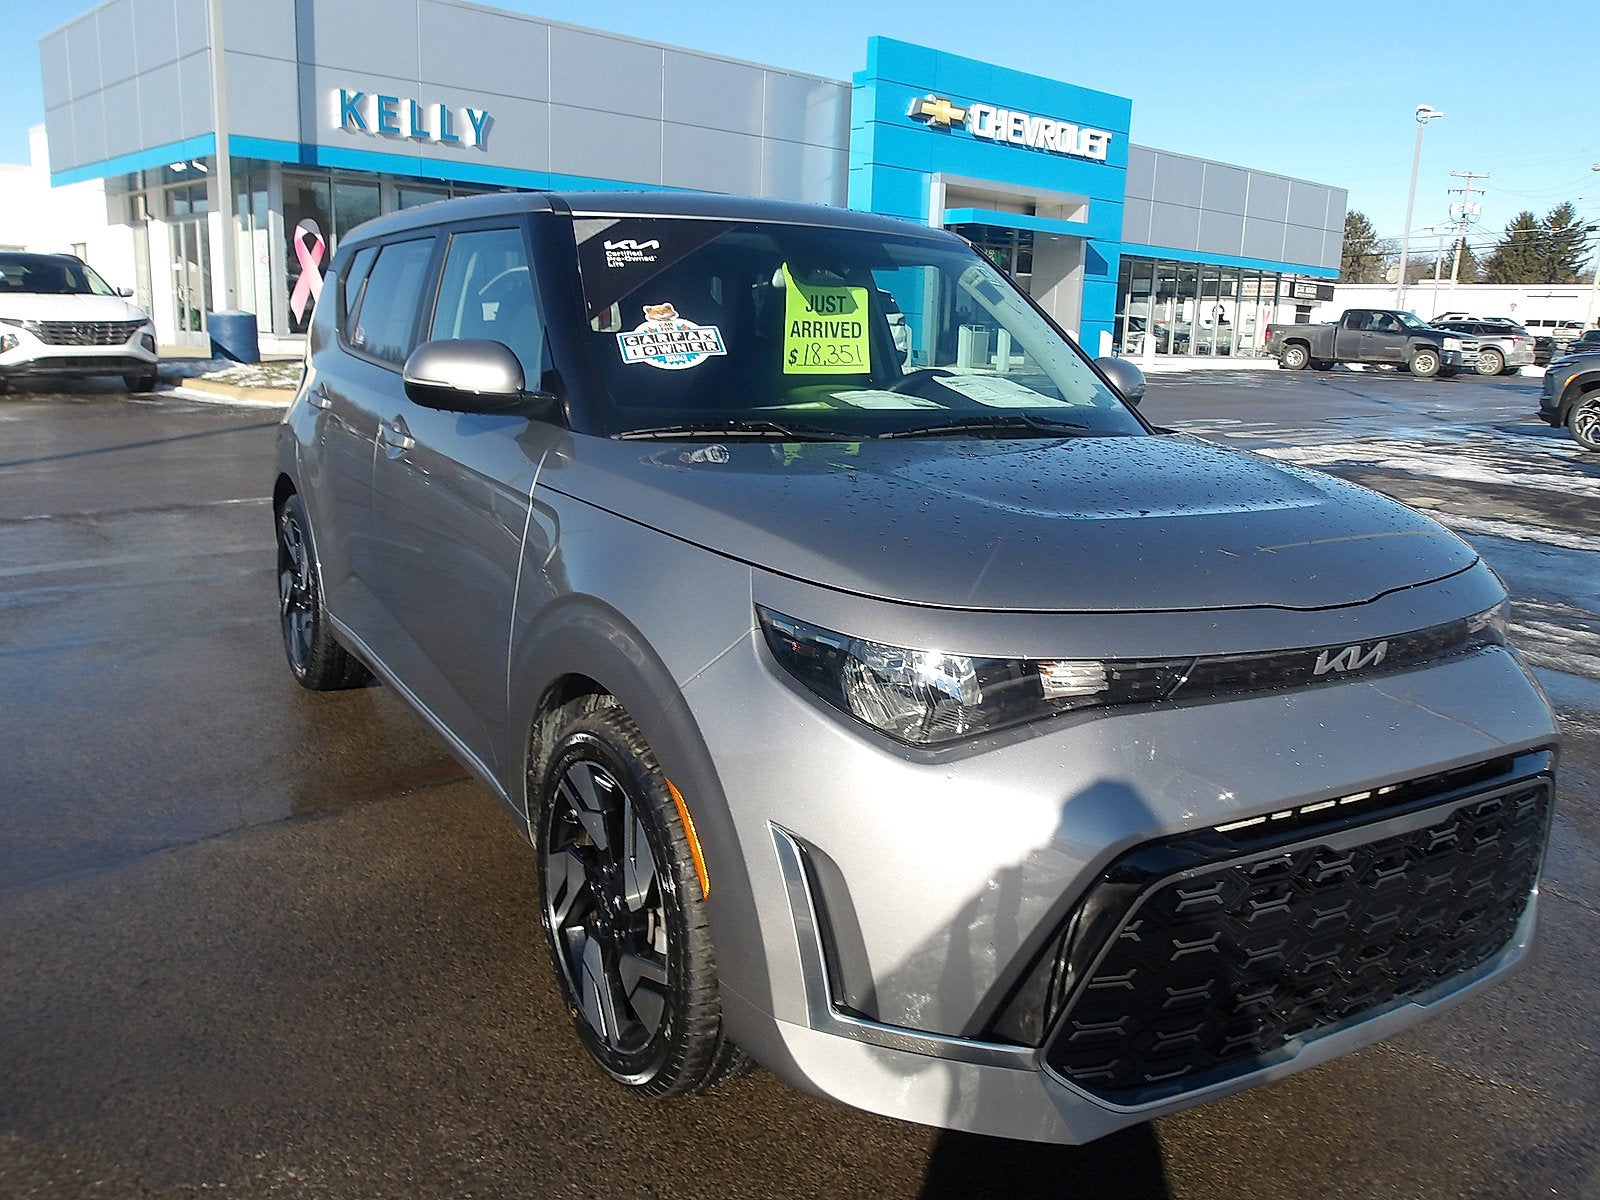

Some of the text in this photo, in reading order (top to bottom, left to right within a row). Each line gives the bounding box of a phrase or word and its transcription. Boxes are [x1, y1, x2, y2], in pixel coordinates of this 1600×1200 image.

[335, 87, 490, 147] KELLY
[970, 103, 1113, 161] CHEVROLET
[805, 294, 847, 313] JUST
[624, 331, 713, 347] CARFAX
[789, 320, 862, 339] ARRIVED
